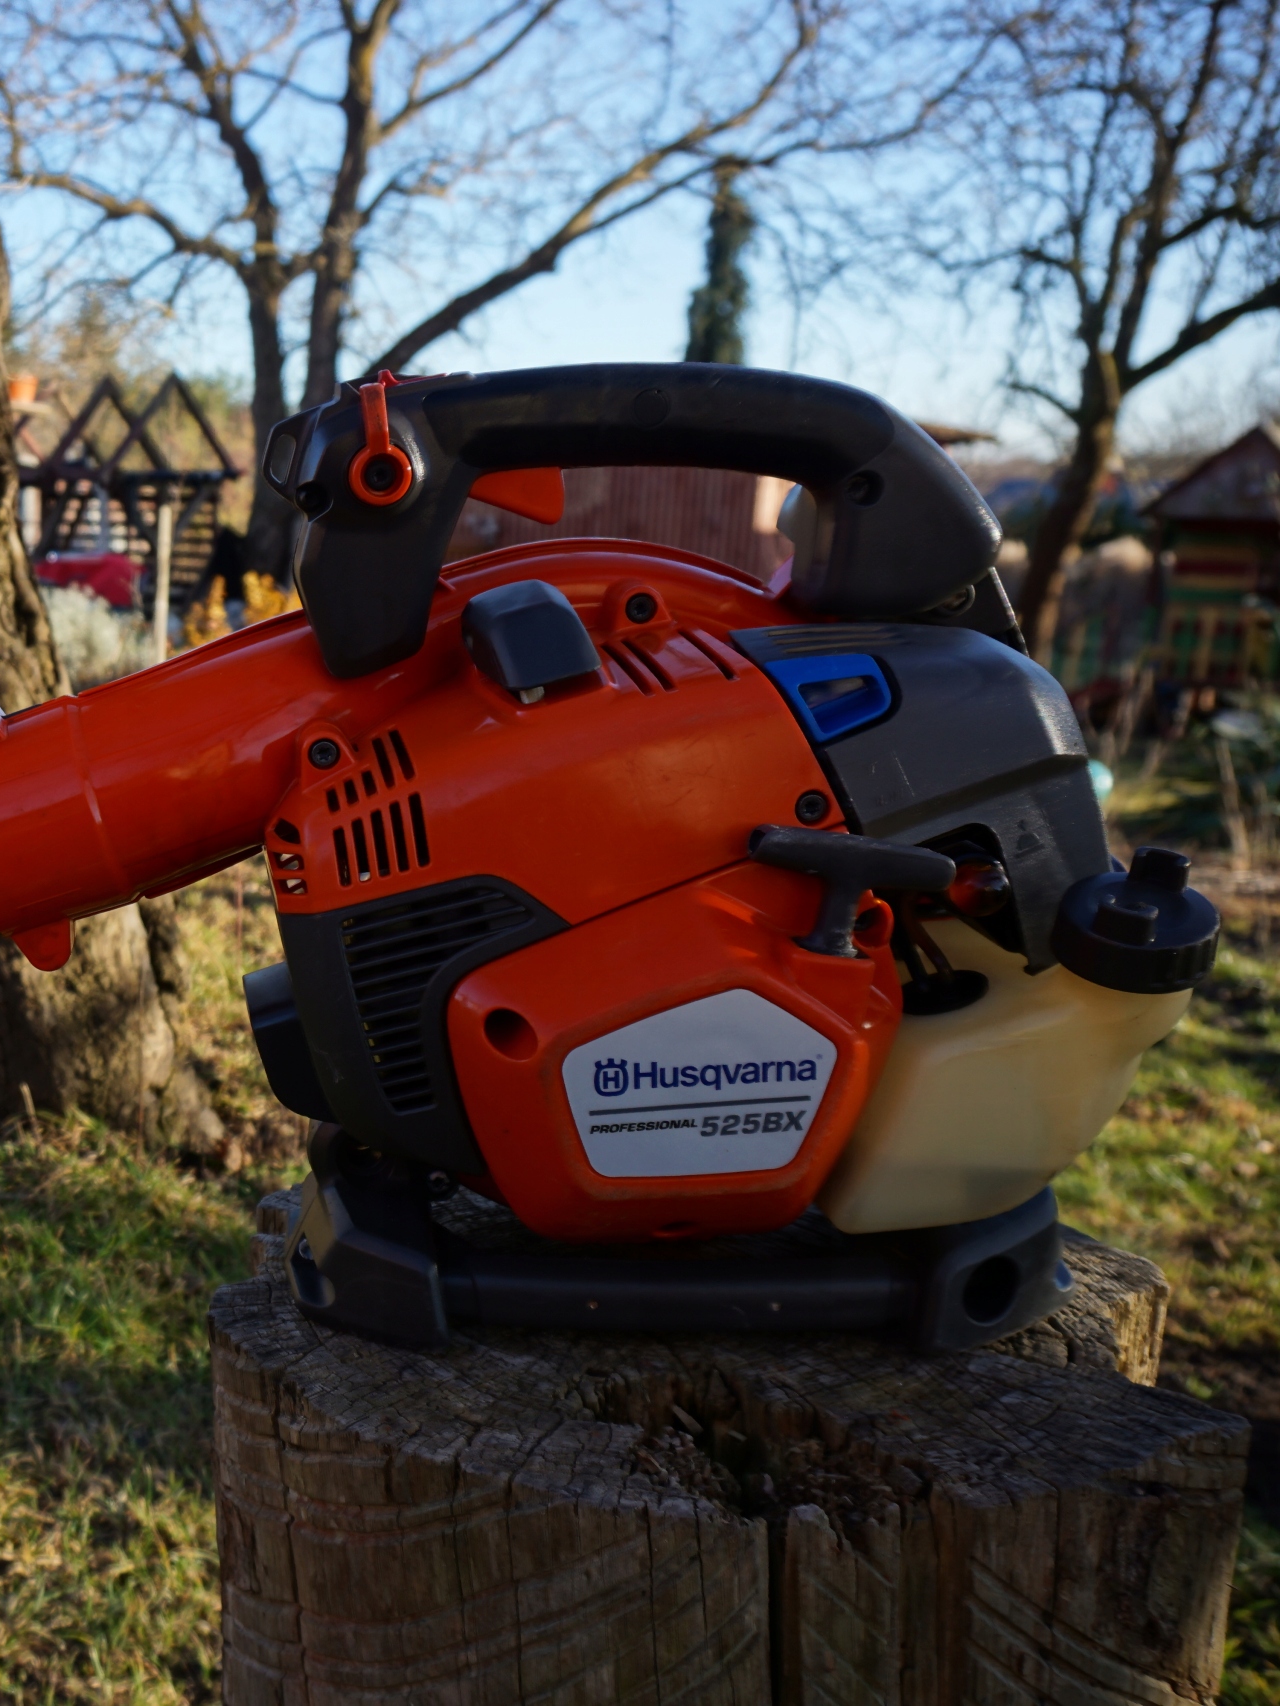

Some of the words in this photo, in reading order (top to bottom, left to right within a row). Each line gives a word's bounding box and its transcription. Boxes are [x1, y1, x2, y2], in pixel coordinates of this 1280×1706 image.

[633, 1058, 818, 1090] Husqvarna
[589, 1118, 698, 1135] PROFESSIONAL
[700, 1109, 807, 1137] 525BX
